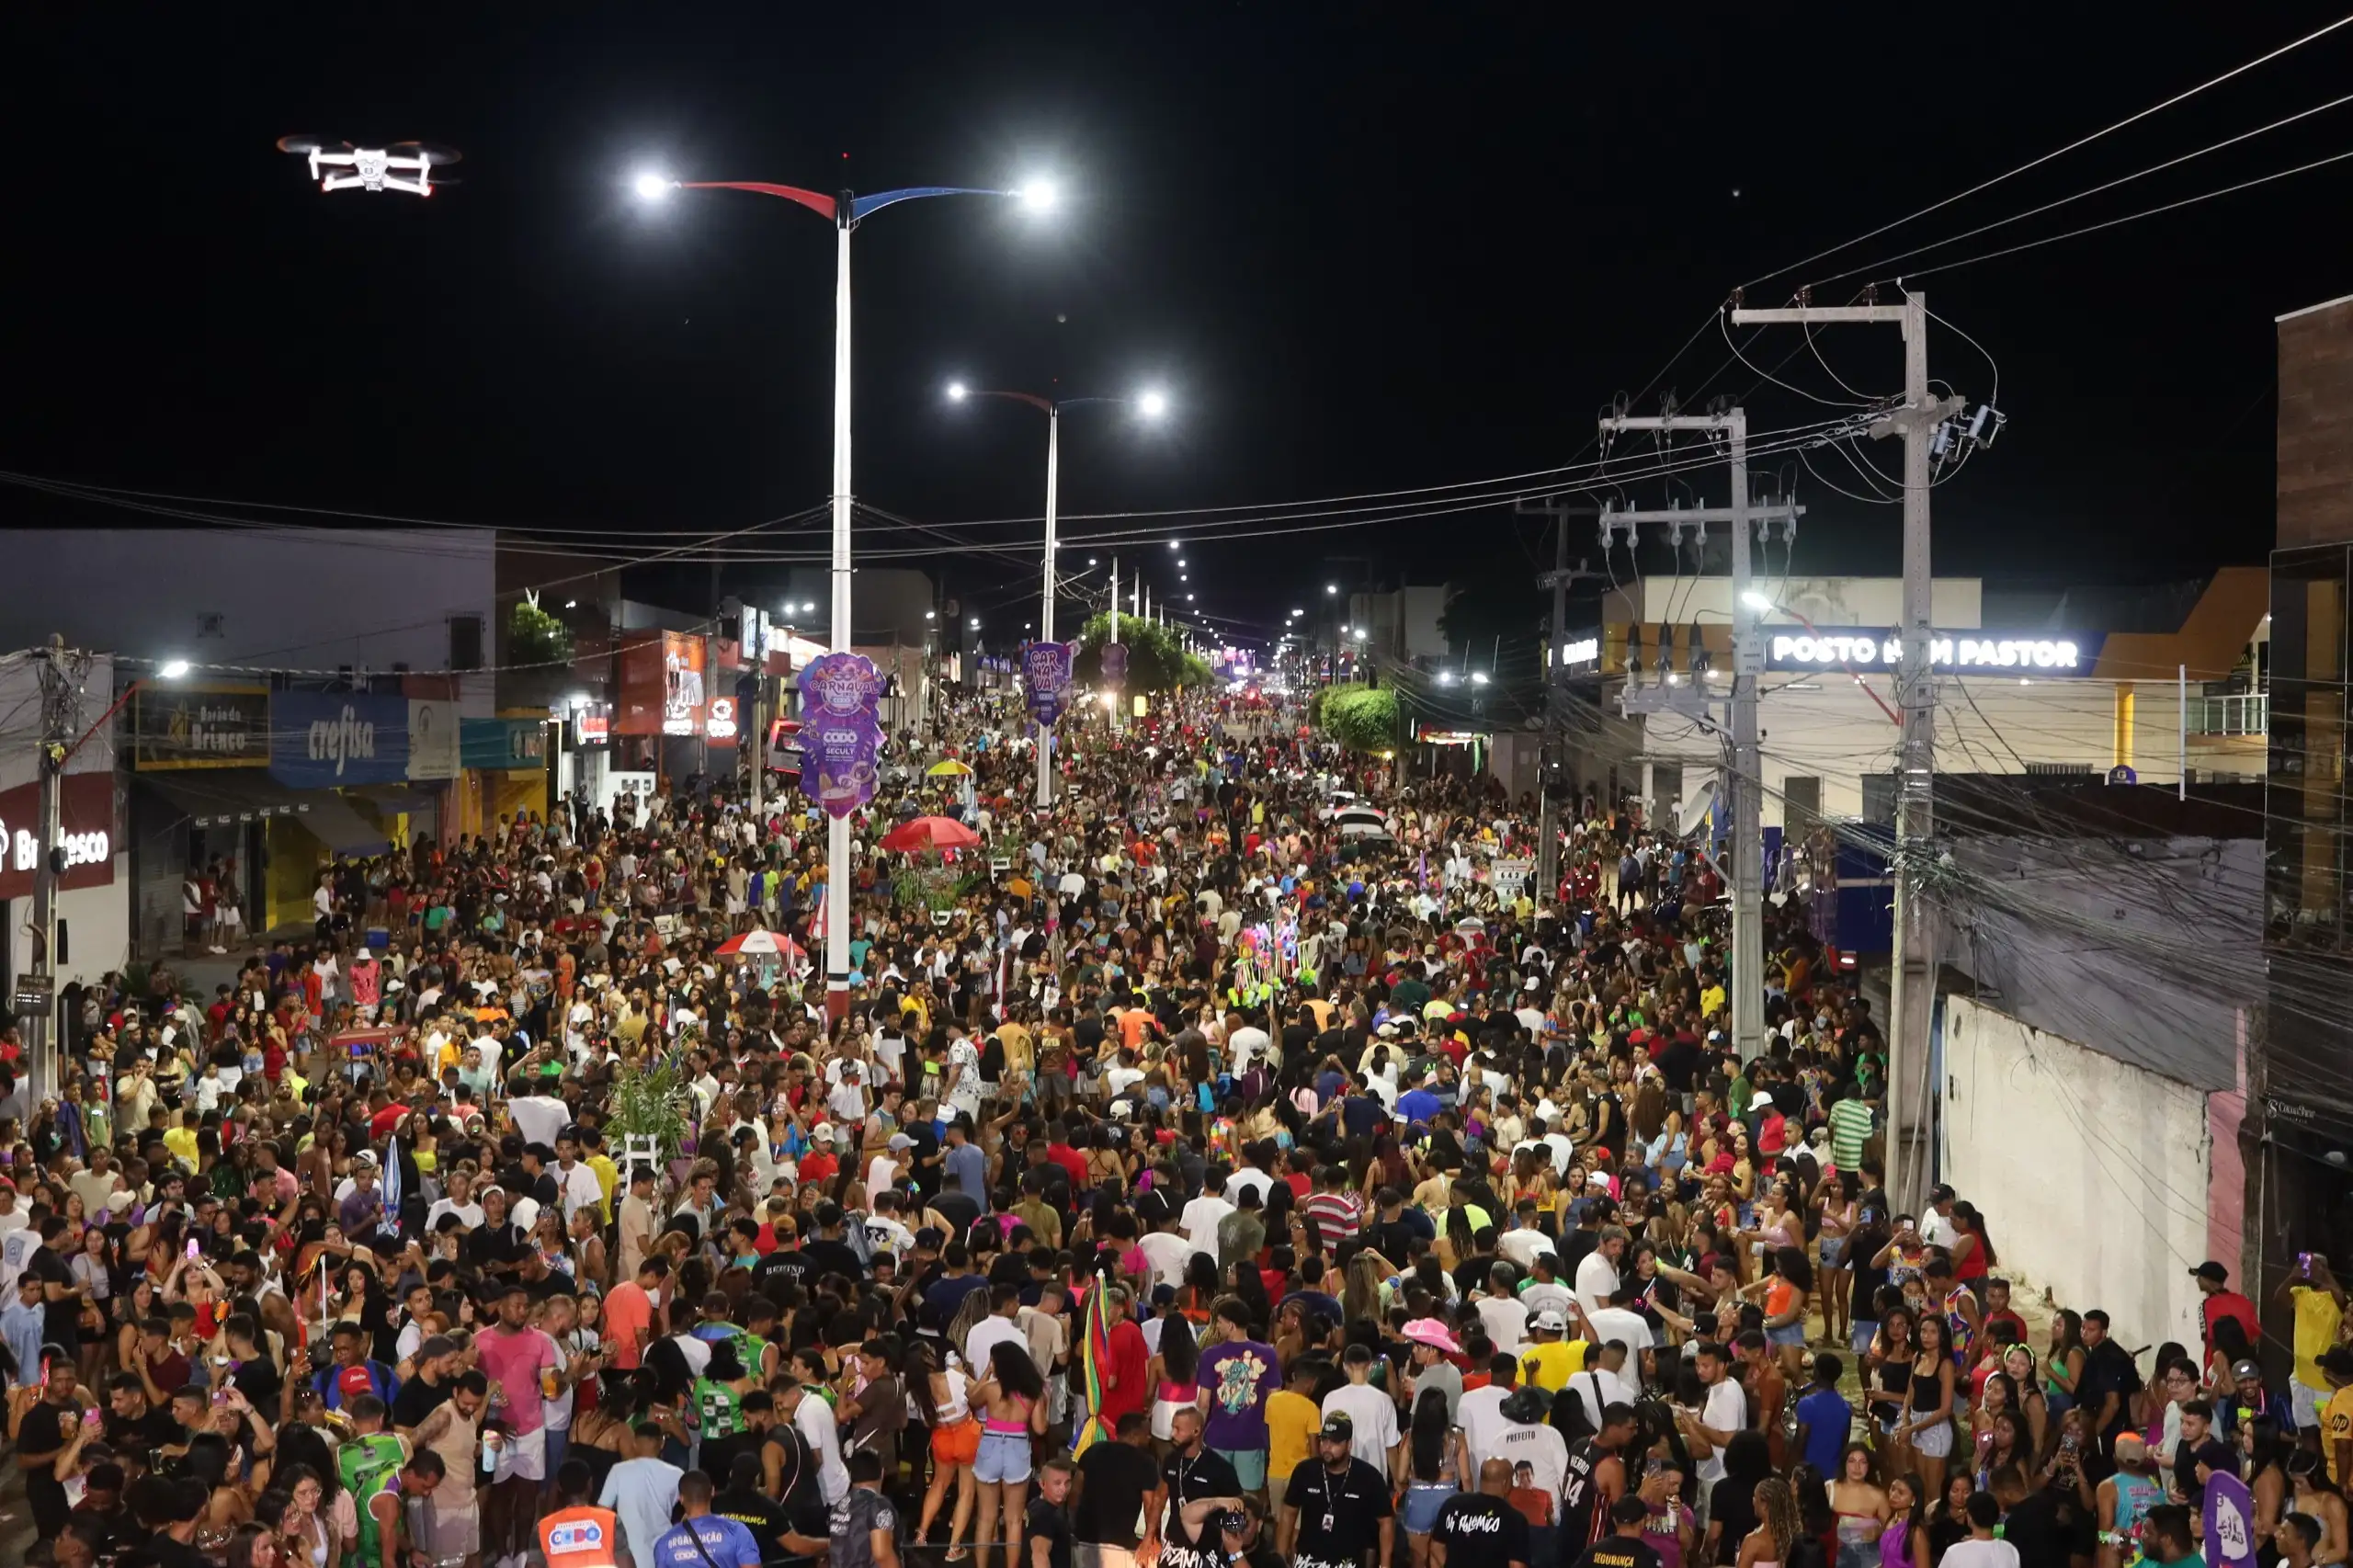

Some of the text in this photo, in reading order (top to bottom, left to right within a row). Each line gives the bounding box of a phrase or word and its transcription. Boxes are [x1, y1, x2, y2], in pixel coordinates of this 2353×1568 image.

[1773, 636, 1877, 664] POSTO
[1959, 640, 2078, 667] PASTOR
[809, 680, 879, 696] CARNAVAL
[309, 704, 375, 777] crefisa
[1506, 1431, 1536, 1444] PREFEITO
[1570, 1455, 1590, 1476] HERRO
[1564, 1472, 1586, 1508] 14
[1593, 1552, 1635, 1568] SEGURANÇA
